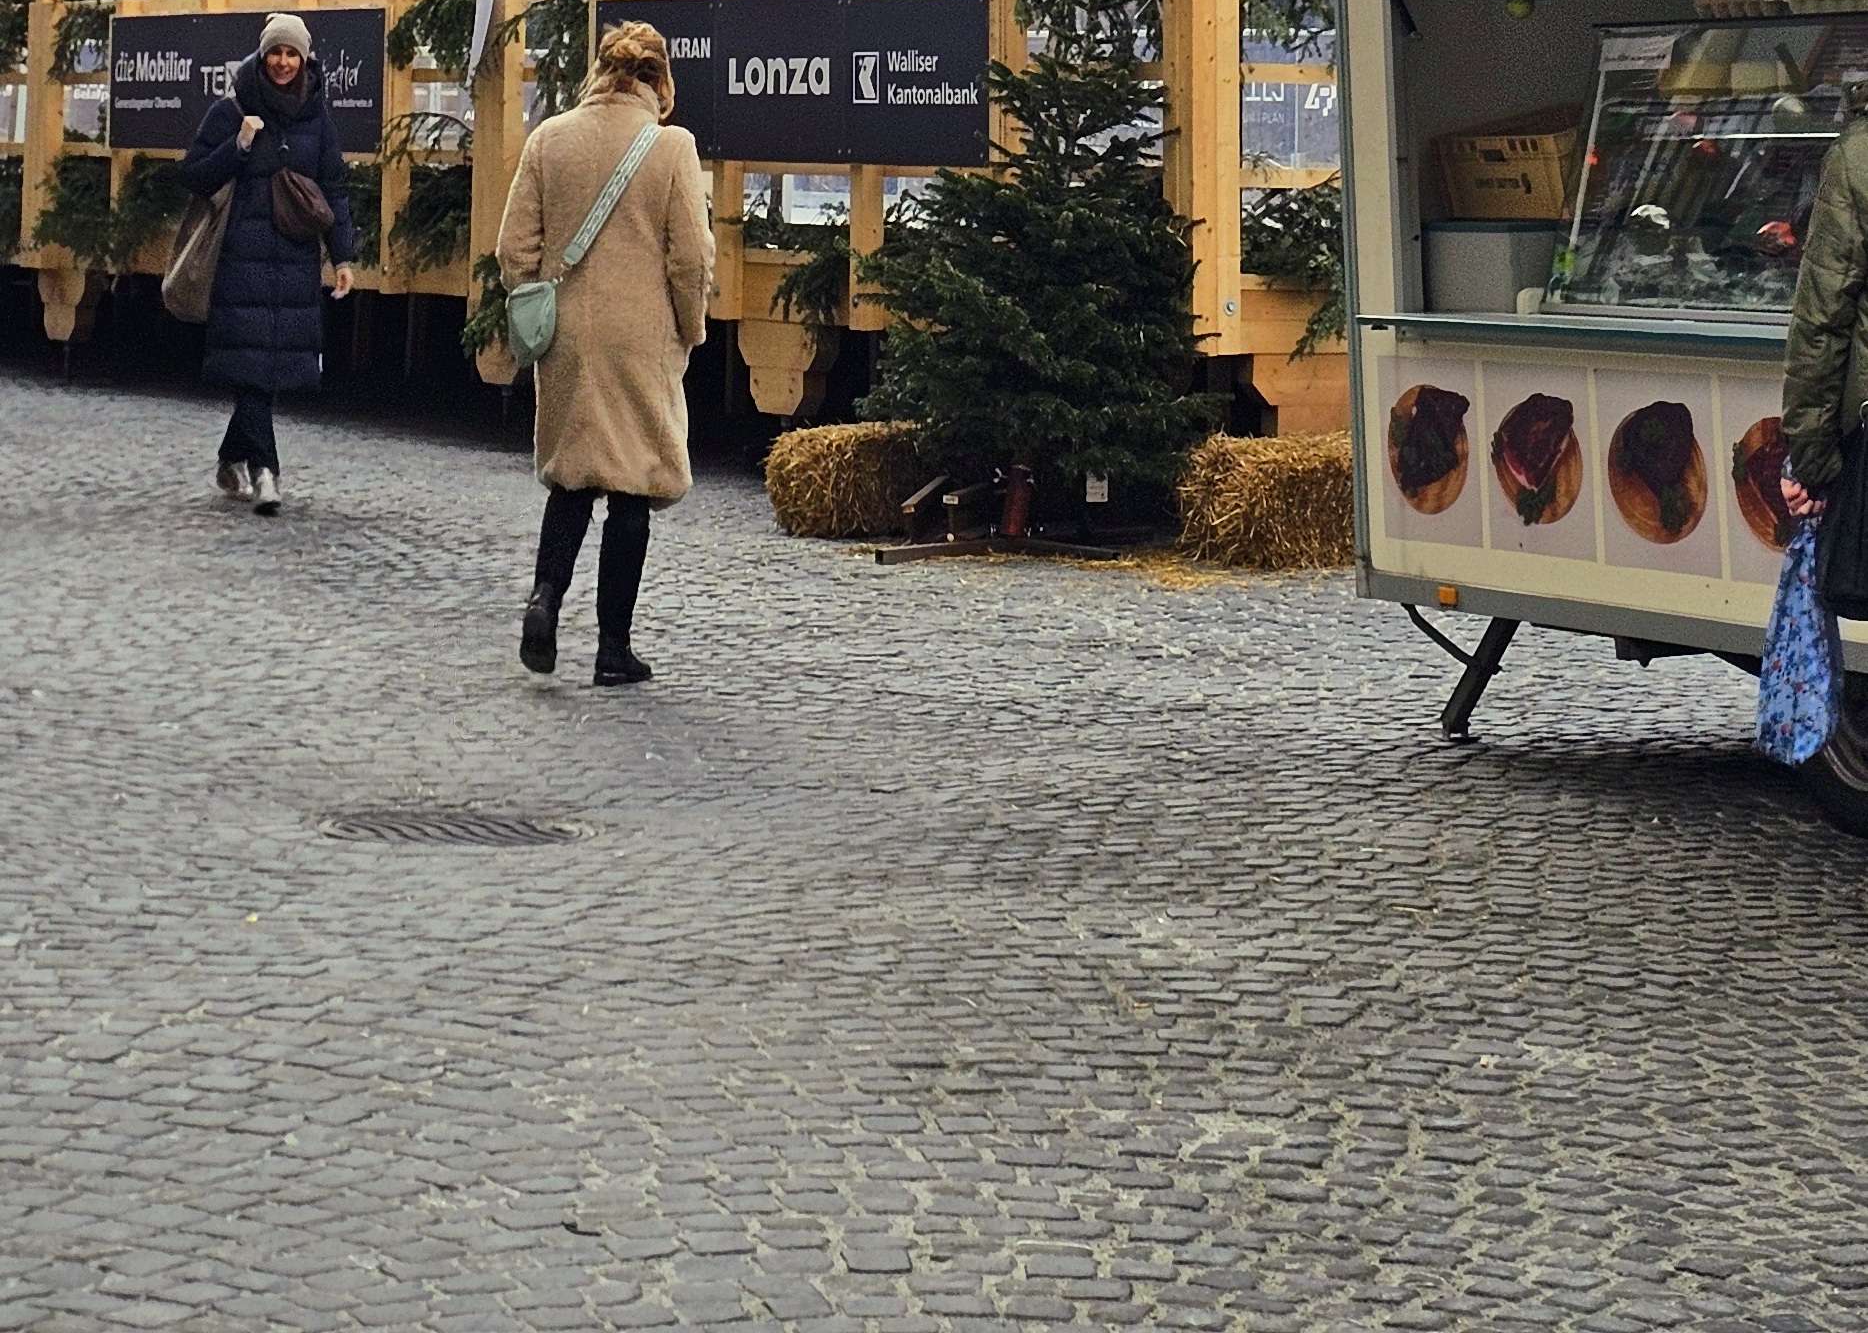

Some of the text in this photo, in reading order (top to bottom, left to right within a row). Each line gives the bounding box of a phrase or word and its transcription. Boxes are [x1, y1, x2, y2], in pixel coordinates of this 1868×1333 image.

[670, 36, 711, 59] KRAN
[115, 51, 193, 82] die Mobiliar
[887, 50, 939, 72] Walliser
[887, 81, 979, 105] Kantonalbank
